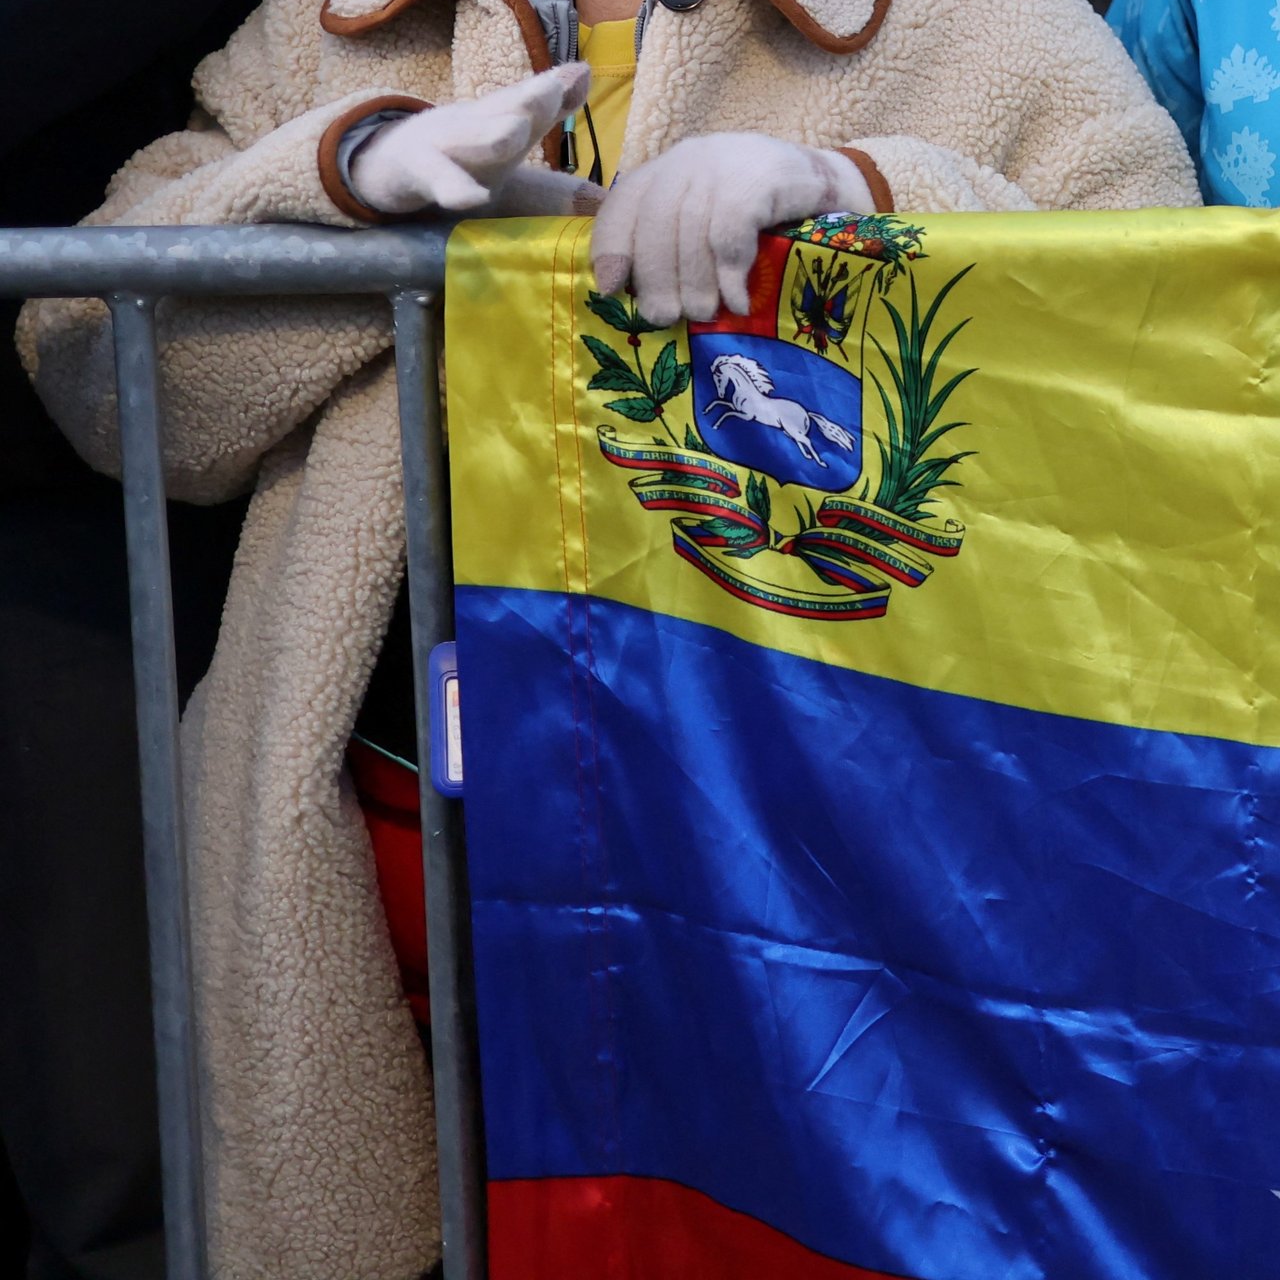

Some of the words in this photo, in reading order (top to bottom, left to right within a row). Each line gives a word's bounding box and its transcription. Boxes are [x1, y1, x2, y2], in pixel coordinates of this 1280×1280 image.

[620, 448, 635, 459] DE
[642, 451, 677, 463] ABRIL
[683, 455, 701, 467] DE
[643, 490, 750, 518] INDEPENDENCIA
[824, 500, 841, 510] 20
[913, 531, 928, 542] DE
[932, 535, 958, 548] 1859
